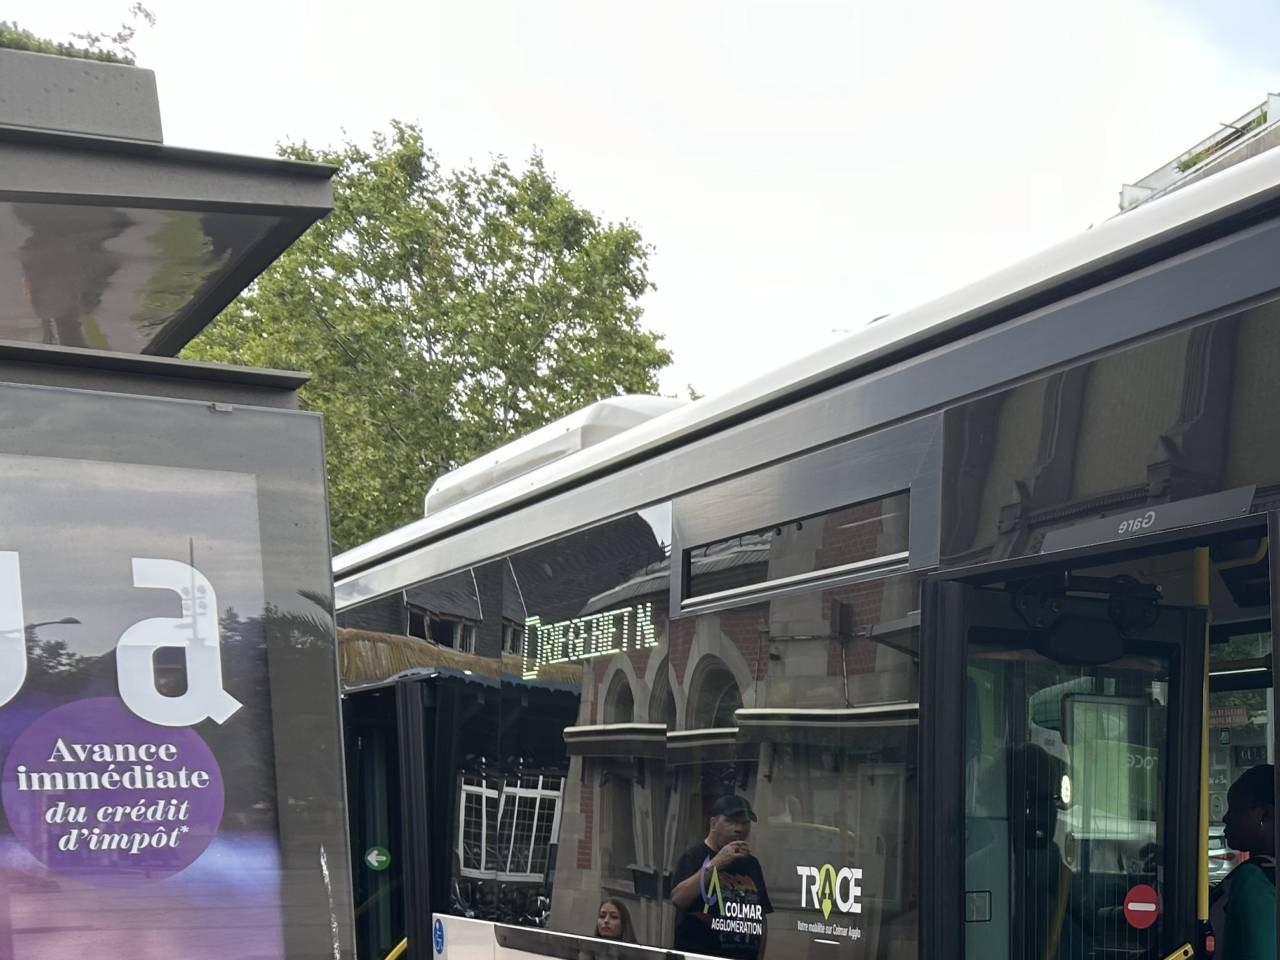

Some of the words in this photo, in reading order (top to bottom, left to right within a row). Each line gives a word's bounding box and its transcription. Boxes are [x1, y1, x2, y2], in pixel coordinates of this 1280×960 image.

[47, 738, 178, 763] Avance
[16, 765, 210, 791] immédiate
[45, 801, 87, 824] du
[96, 799, 190, 823] crédit
[796, 863, 862, 920] TRACE
[725, 901, 762, 920] COLMAR
